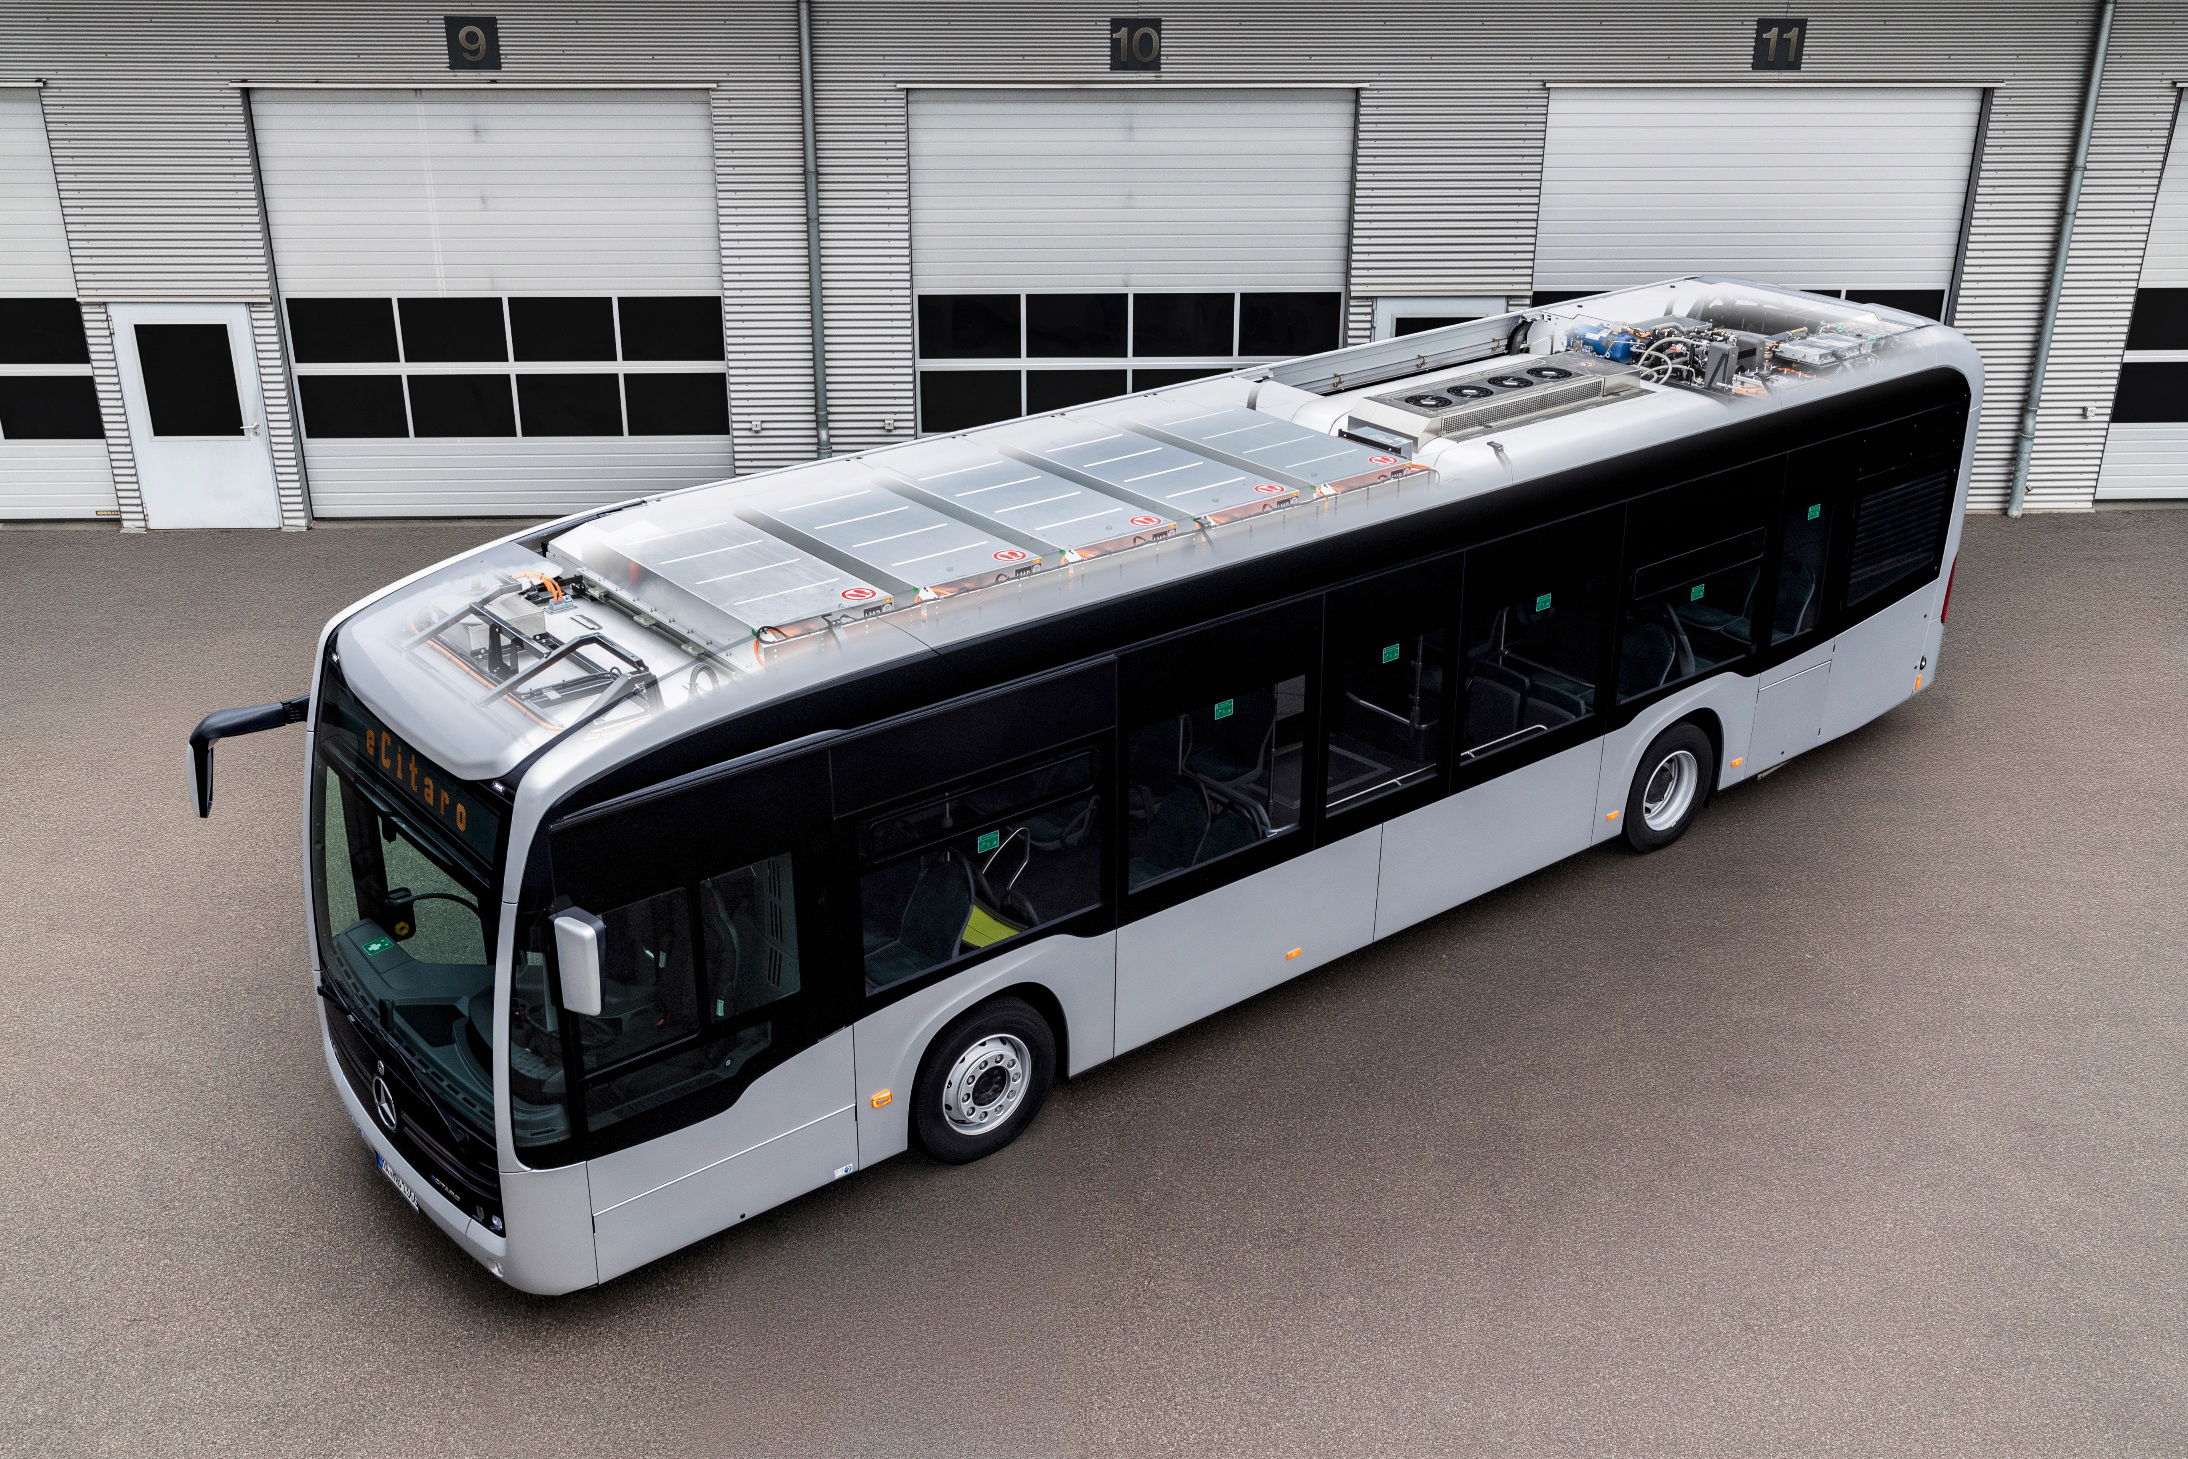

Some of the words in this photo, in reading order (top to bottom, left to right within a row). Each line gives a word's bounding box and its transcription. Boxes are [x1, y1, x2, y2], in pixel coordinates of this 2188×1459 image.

[458, 25, 487, 62] 9
[1112, 26, 1160, 63] 10
[1762, 27, 1799, 62] 11
[366, 729, 467, 832] eCitaro
